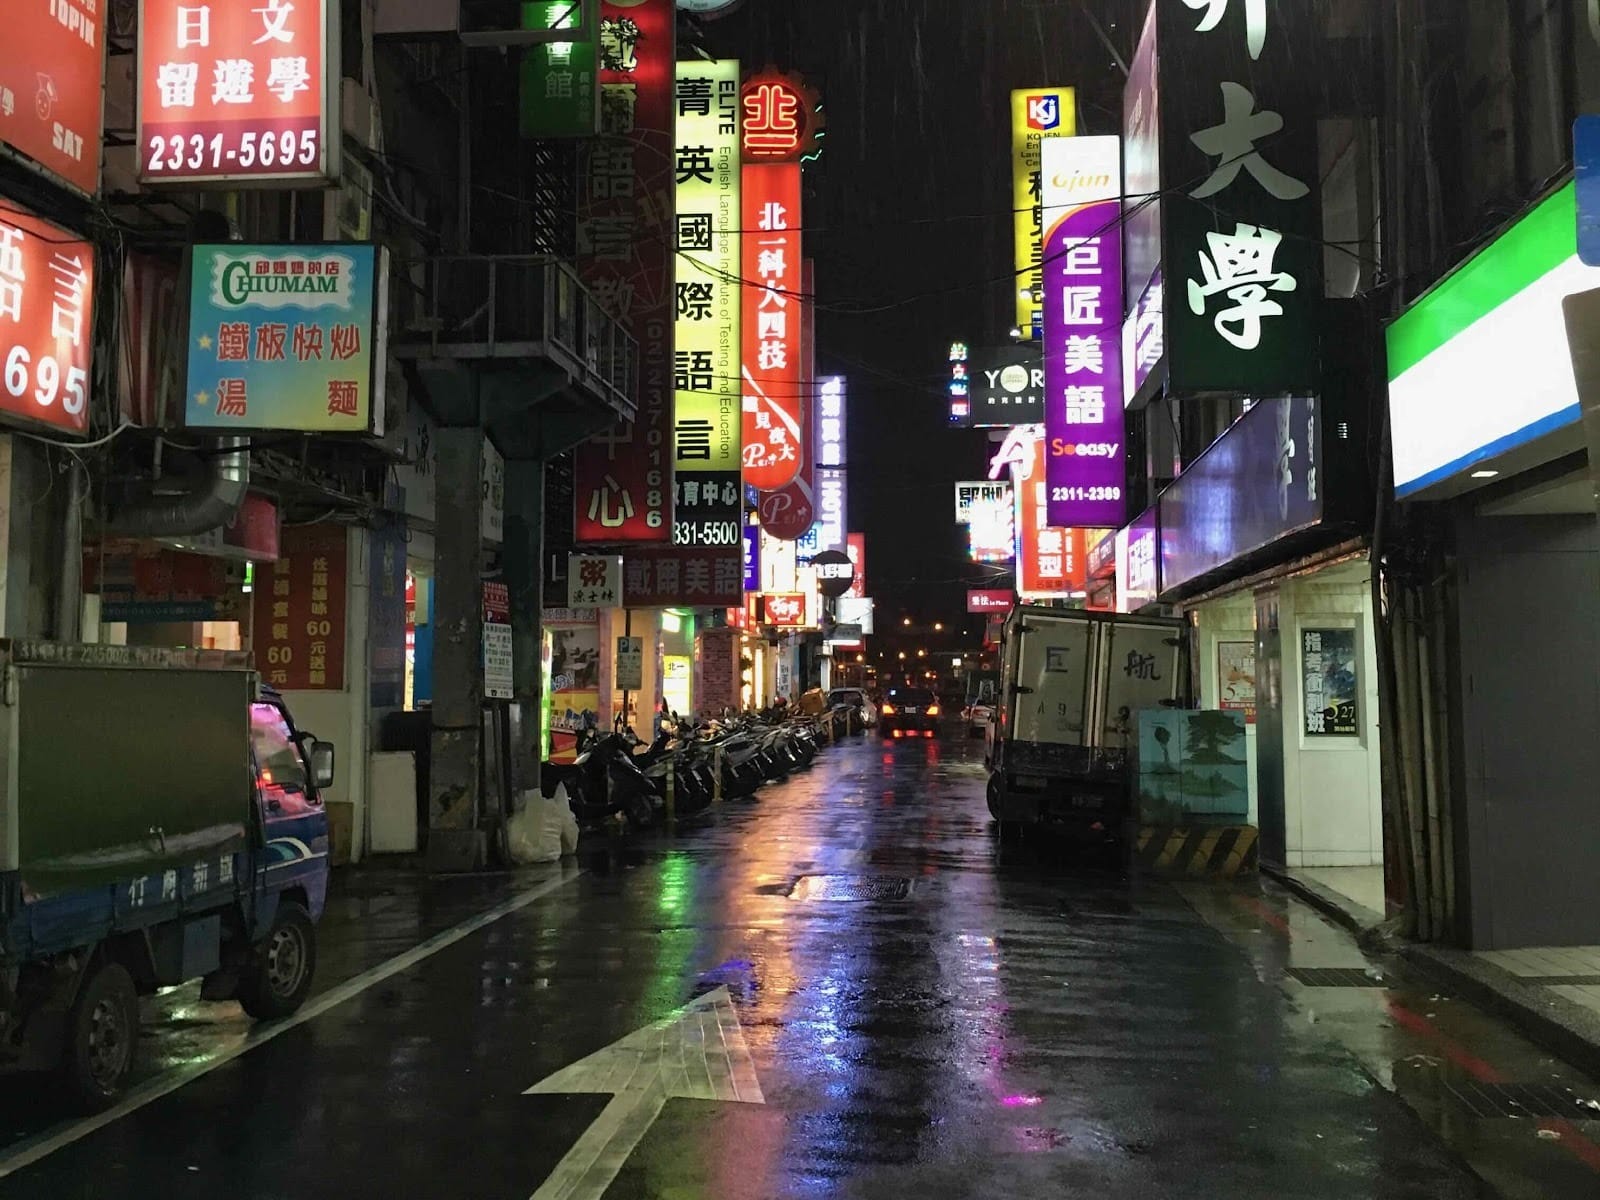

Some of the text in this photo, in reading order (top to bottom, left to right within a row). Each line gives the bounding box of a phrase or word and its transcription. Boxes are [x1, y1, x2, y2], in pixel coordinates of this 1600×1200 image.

[50, 0, 95, 48] TOPIK
[177, 0, 297, 48] 日文
[157, 56, 311, 108] 留遊學
[718, 80, 735, 135] ELITE
[53, 121, 83, 162] SAT
[148, 130, 317, 171] 2331-5695
[718, 146, 731, 190] English
[718, 194, 731, 253] Language
[222, 261, 338, 305] CHIUMAM
[675, 77, 714, 460] 菁英國際語言
[719, 309, 731, 321] of
[1062, 236, 1105, 424] 巨匠美語
[218, 322, 361, 363] 鐵板快炒
[719, 323, 731, 367] Testing
[5, 344, 87, 416] 695
[216, 378, 359, 417] 湯麵
[719, 370, 731, 394] and
[719, 398, 732, 459] Education
[580, 559, 607, 587] 粥
